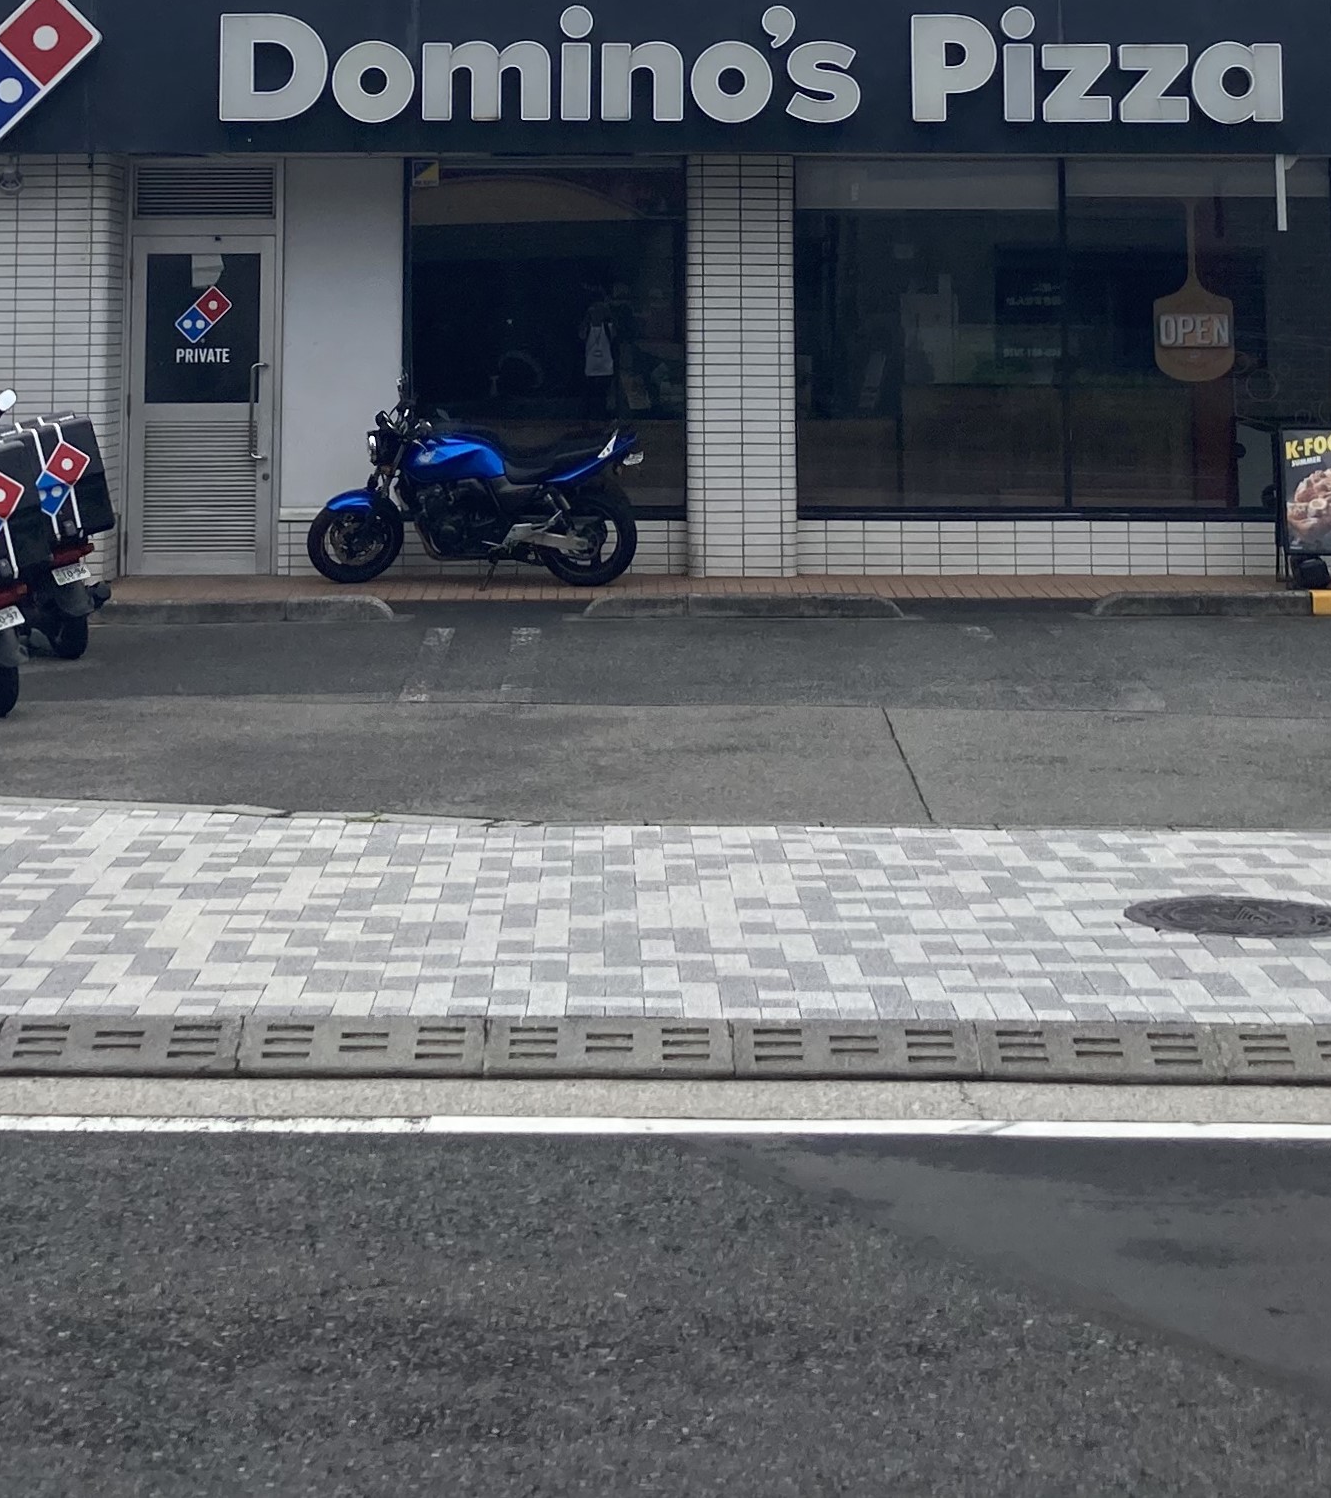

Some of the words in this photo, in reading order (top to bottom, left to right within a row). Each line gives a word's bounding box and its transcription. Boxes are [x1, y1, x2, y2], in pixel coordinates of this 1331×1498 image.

[220, 6, 860, 123] Domino's
[911, 6, 1283, 123] Pizza
[1159, 314, 1229, 346] OPEN
[175, 348, 231, 363] PRIVATE
